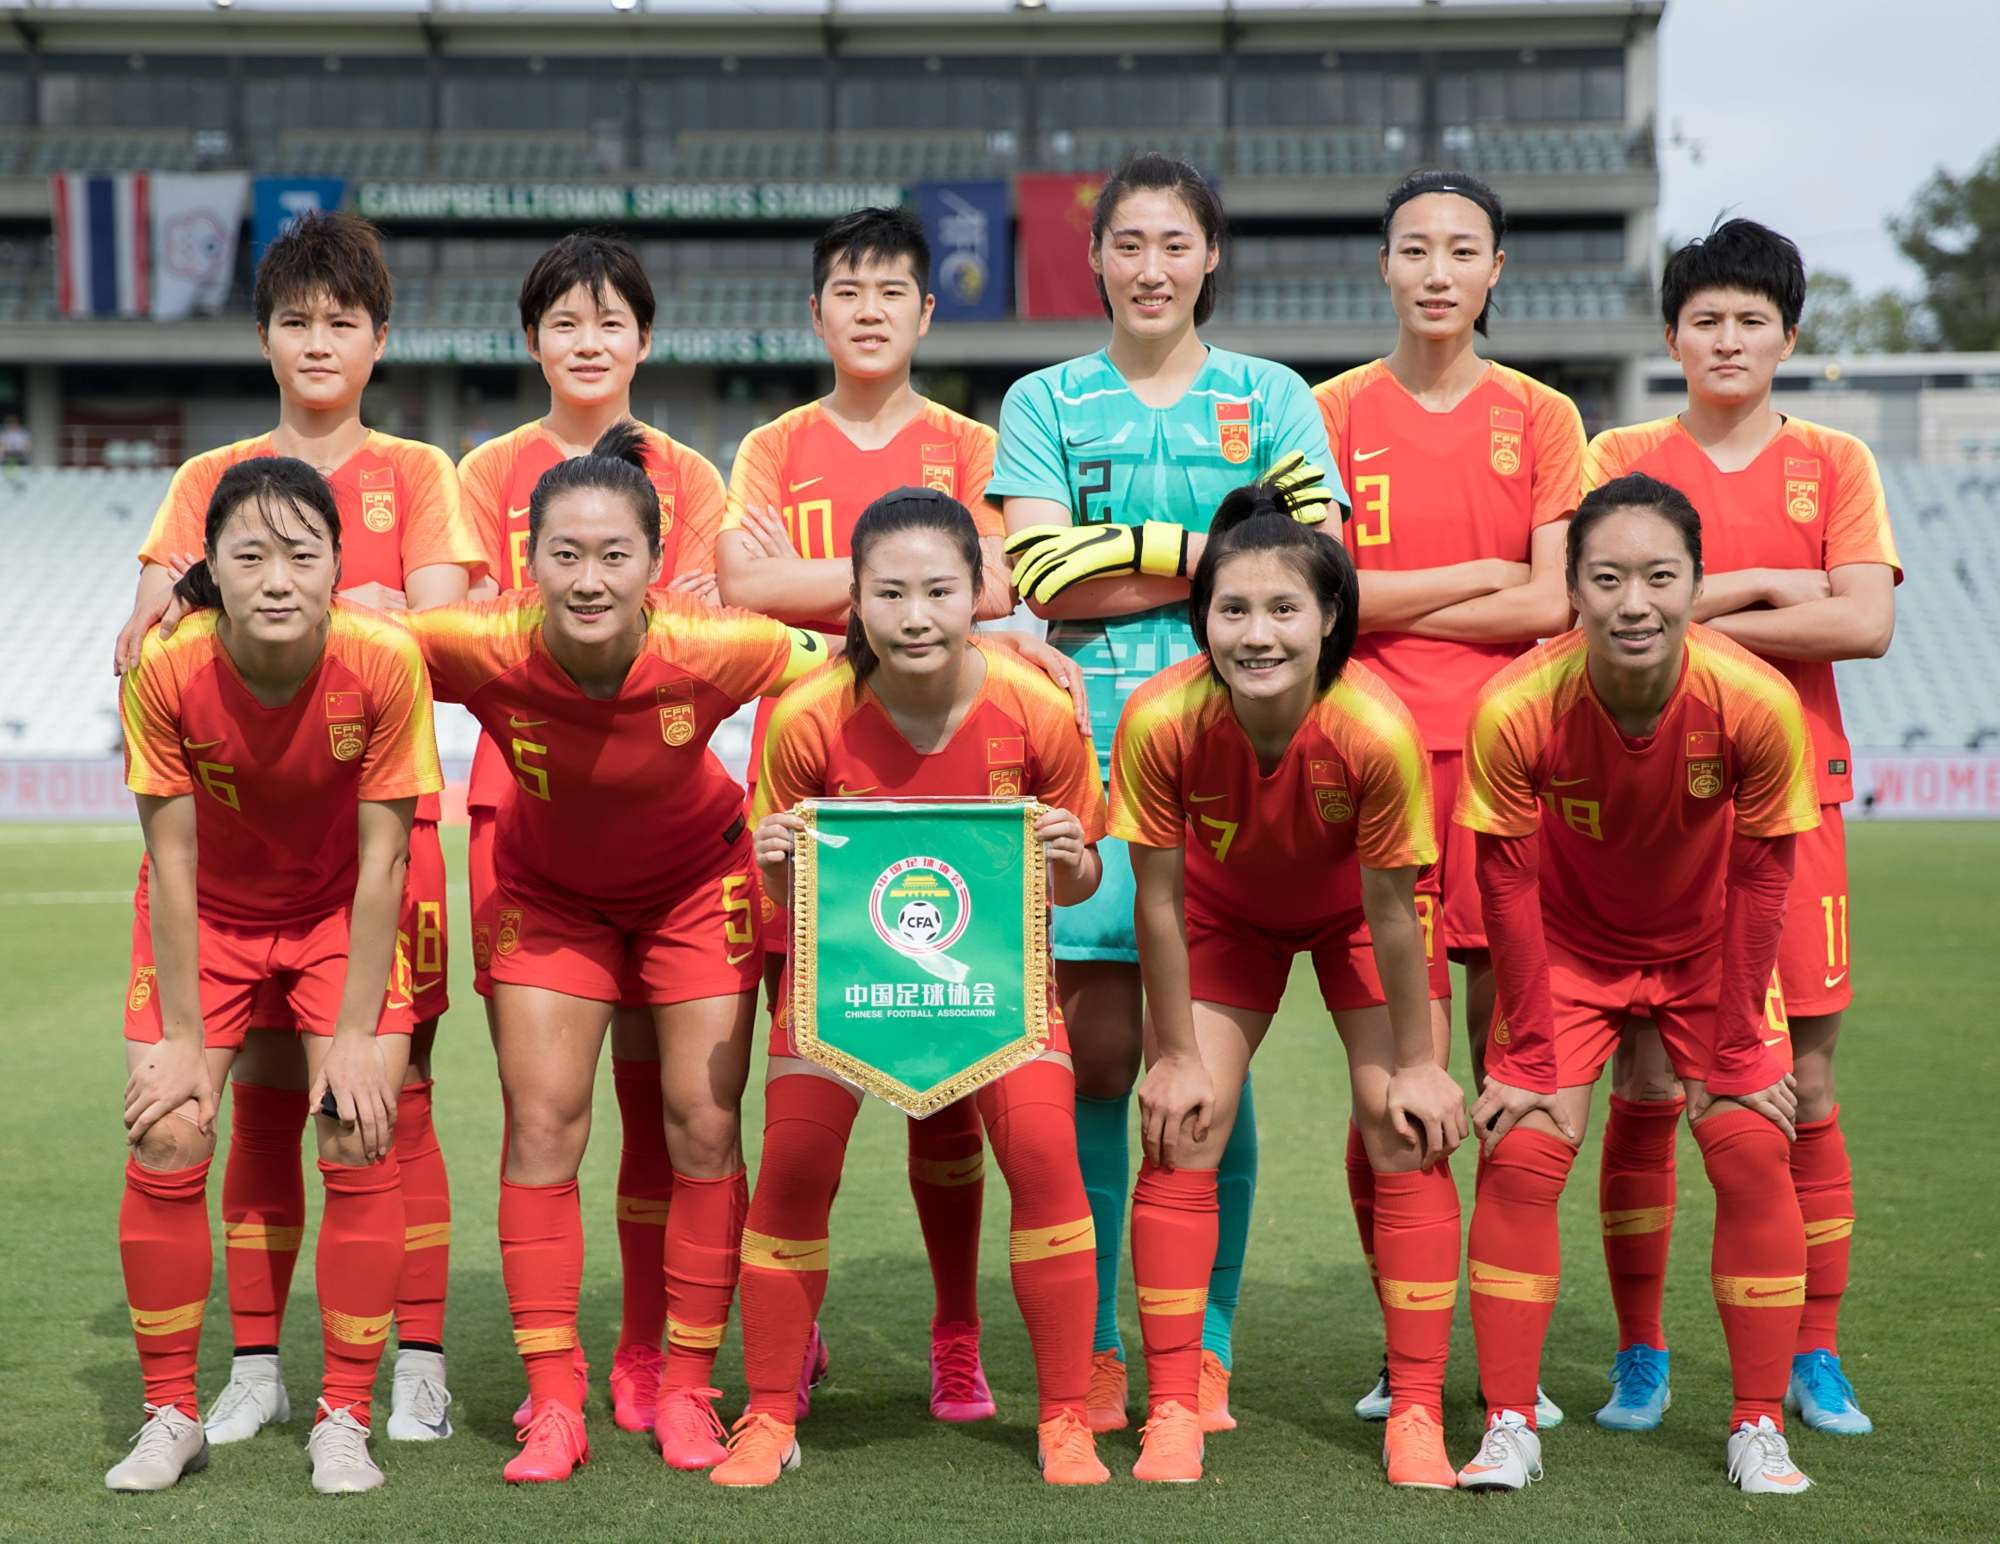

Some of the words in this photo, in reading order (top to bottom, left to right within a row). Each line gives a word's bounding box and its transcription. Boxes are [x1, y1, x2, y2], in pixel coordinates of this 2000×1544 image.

[360, 184, 624, 217] CAMPBELLTOWN
[635, 184, 754, 217] SPORTS
[761, 184, 900, 217] STADIUM
[651, 328, 754, 362] PORTS
[1078, 460, 1112, 526] 2
[1355, 474, 1391, 547] 3
[192, 760, 240, 812] 6
[511, 738, 551, 801] 5
[1186, 813, 1239, 863] 7
[721, 875, 752, 943] 5
[907, 917, 934, 929] CFA
[1821, 896, 1847, 967] 11
[417, 901, 441, 973] 8
[845, 982, 996, 1008] 中国足球协会
[845, 1010, 883, 1018] CHINESE
[887, 1010, 933, 1018] FOOTBALL
[937, 1009, 996, 1017] ASSOCIATION
